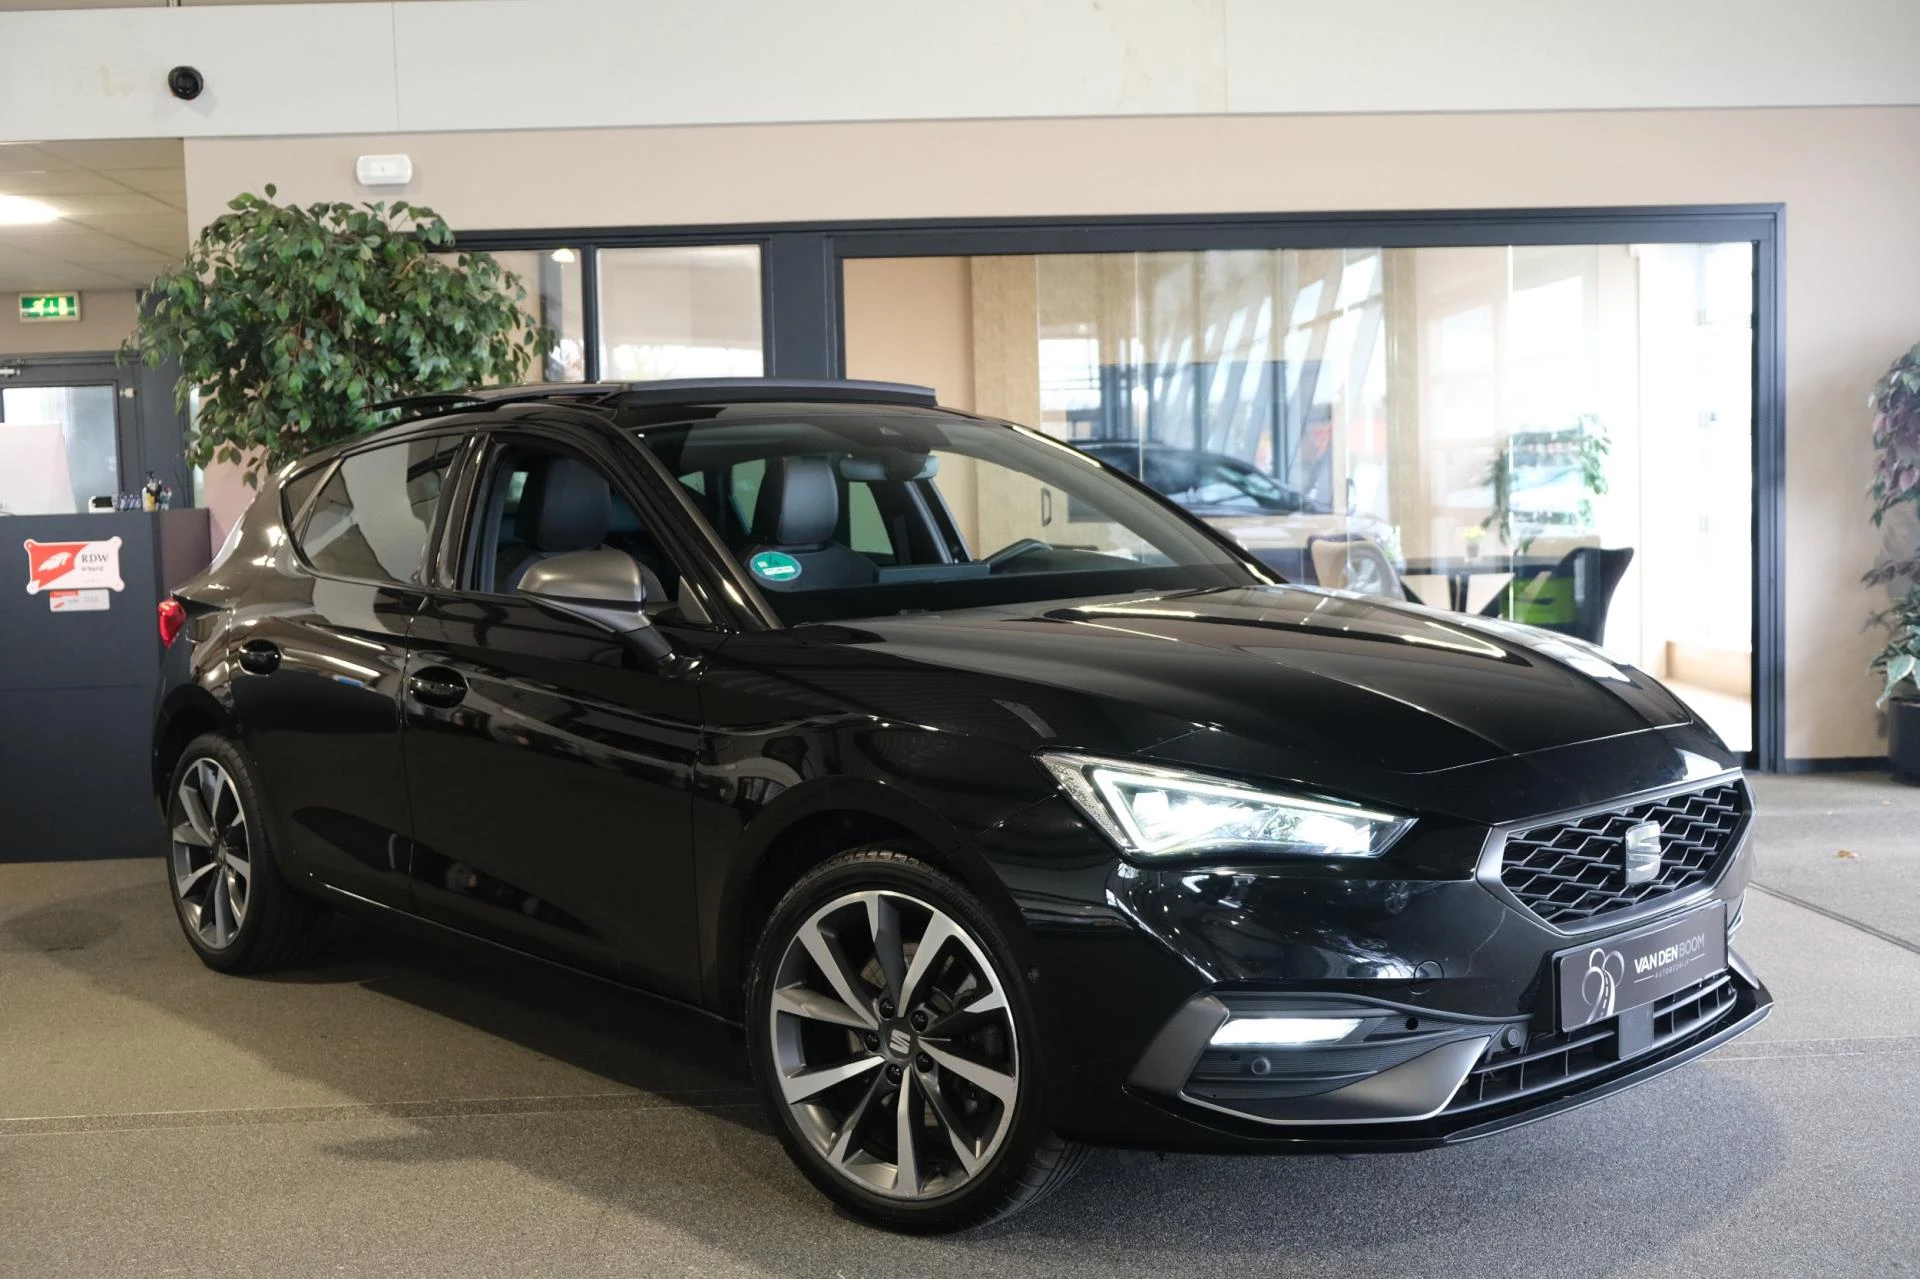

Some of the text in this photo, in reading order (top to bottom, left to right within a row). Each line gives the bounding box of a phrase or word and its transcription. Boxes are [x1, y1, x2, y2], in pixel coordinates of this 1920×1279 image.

[81, 553, 109, 563] RDW
[1634, 932, 1705, 974] VAN DEN BOOM
